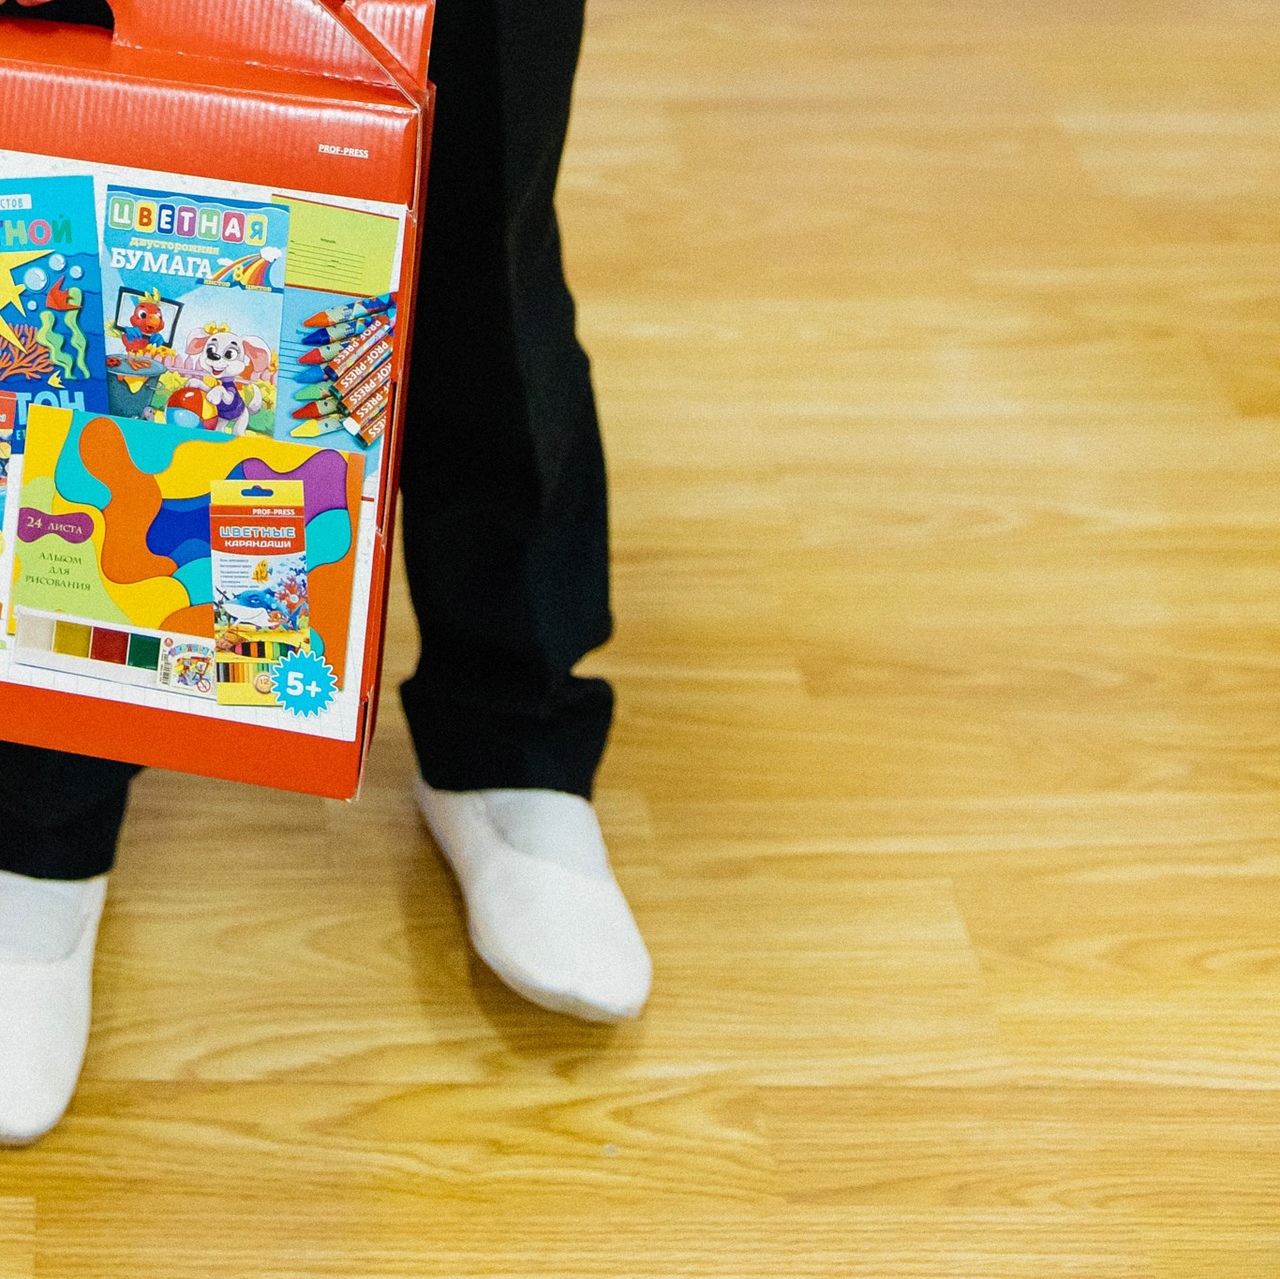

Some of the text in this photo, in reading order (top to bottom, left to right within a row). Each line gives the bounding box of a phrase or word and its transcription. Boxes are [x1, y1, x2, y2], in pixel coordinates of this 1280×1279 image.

[318, 143, 369, 159] PROF-PRESS
[112, 202, 264, 240] ЦВЕТНАЯ
[110, 247, 214, 280] БУМАГА
[333, 319, 382, 364] PROF-PRESS
[340, 340, 390, 388] PROF-PRESS
[26, 515, 83, 535] 24 ЛИСТА
[220, 526, 295, 538] ЦВЕТНЫЕ
[225, 540, 291, 548] КАРАНДАШИ
[38, 552, 82, 565] АЛЬБОМ
[48, 564, 70, 576] ДЛЯ
[25, 575, 91, 591] РИСОВАНИЯ
[286, 672, 322, 697] 5+
